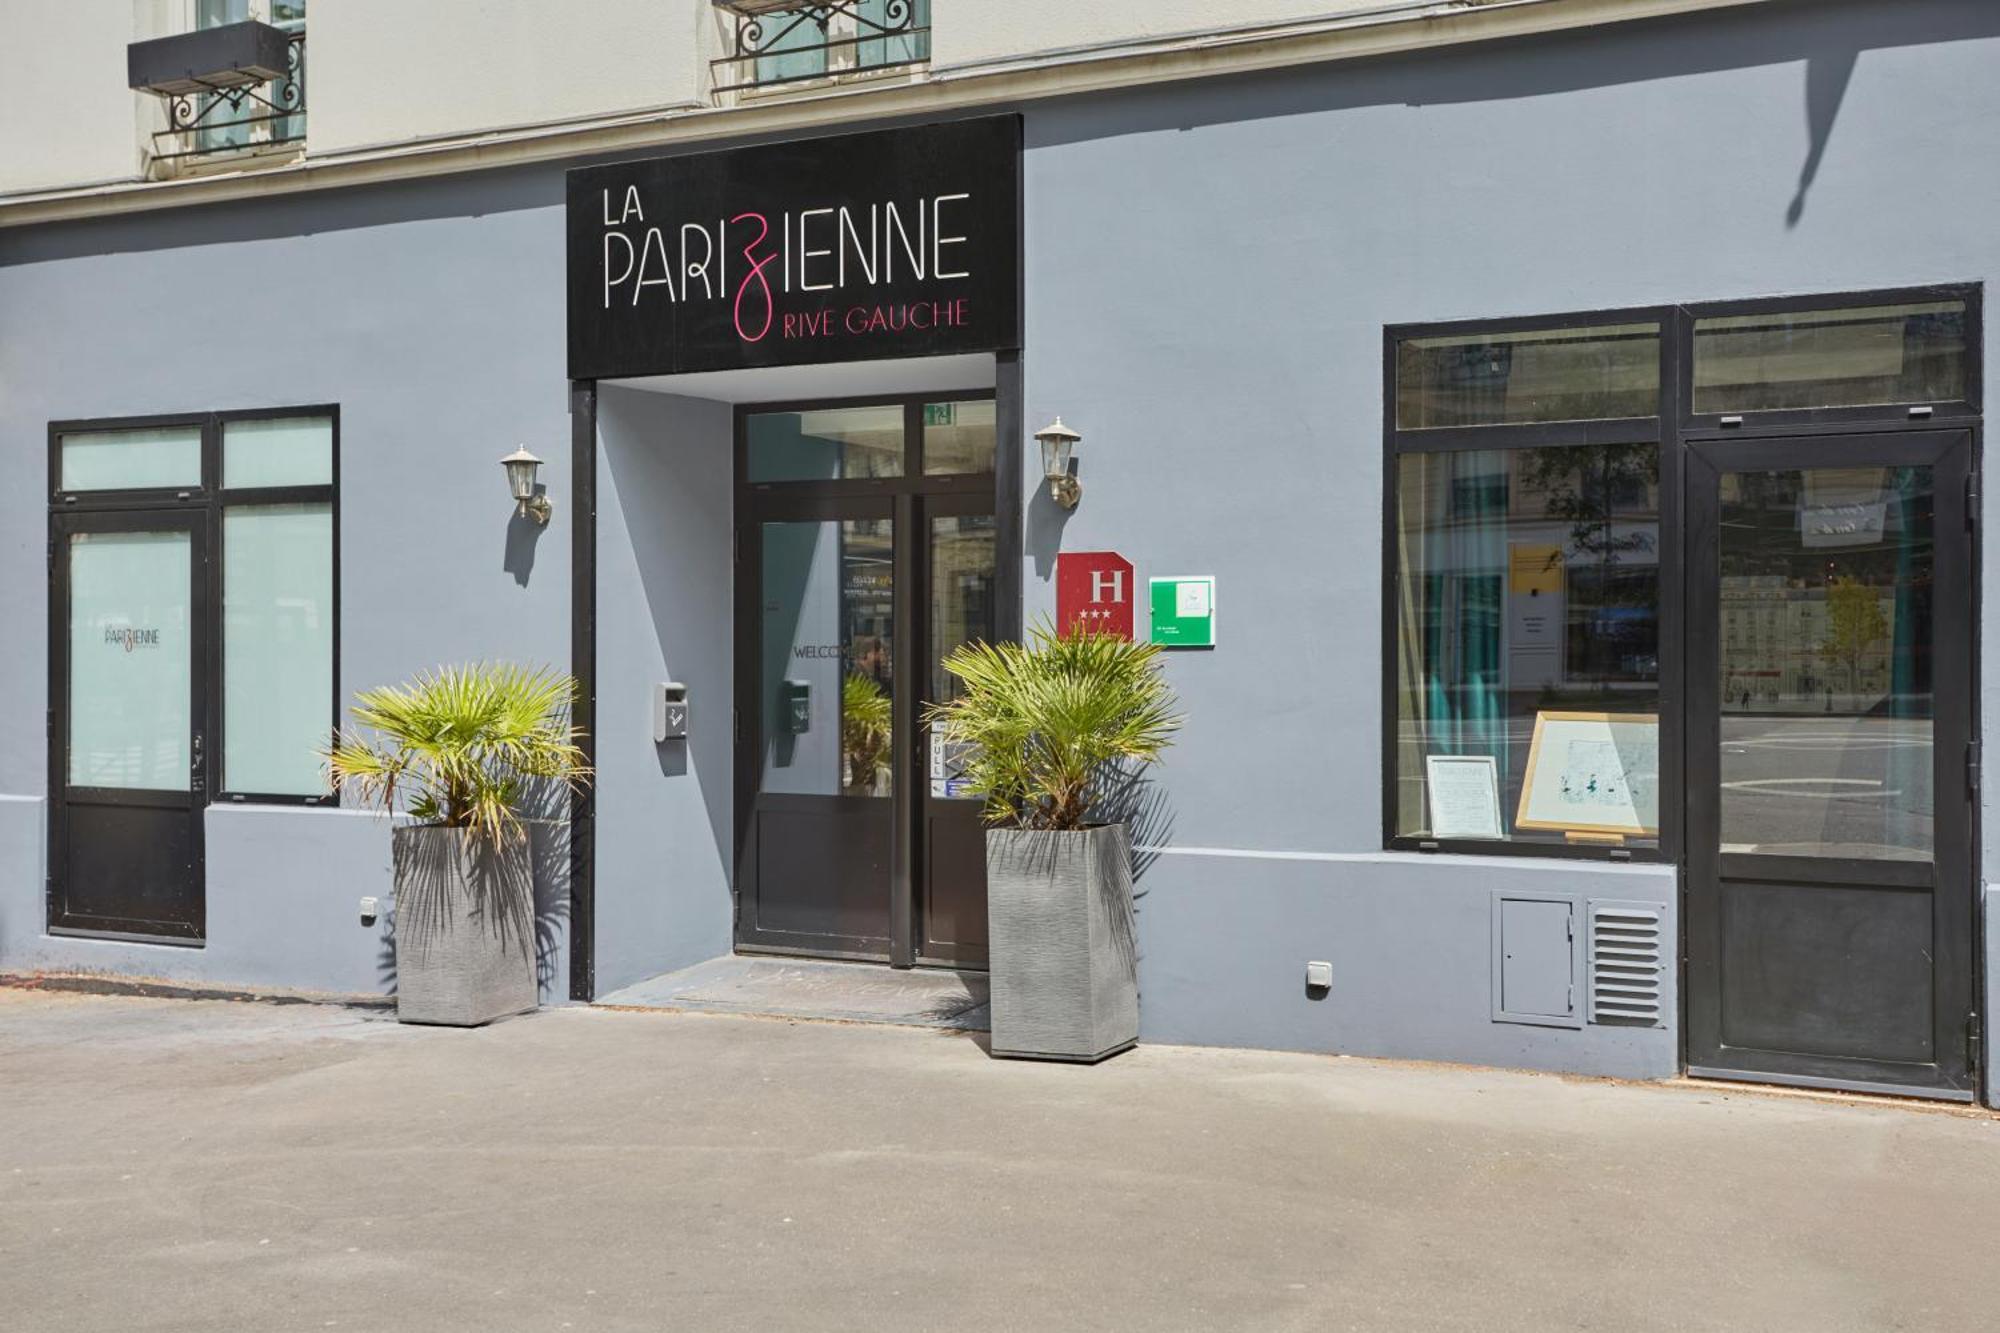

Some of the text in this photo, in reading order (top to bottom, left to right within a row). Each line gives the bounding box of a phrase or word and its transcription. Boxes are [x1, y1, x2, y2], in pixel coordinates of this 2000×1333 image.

[604, 185, 644, 225] LA
[783, 299, 970, 339] RIVE GAUCHE
[1089, 570, 1126, 604] H
